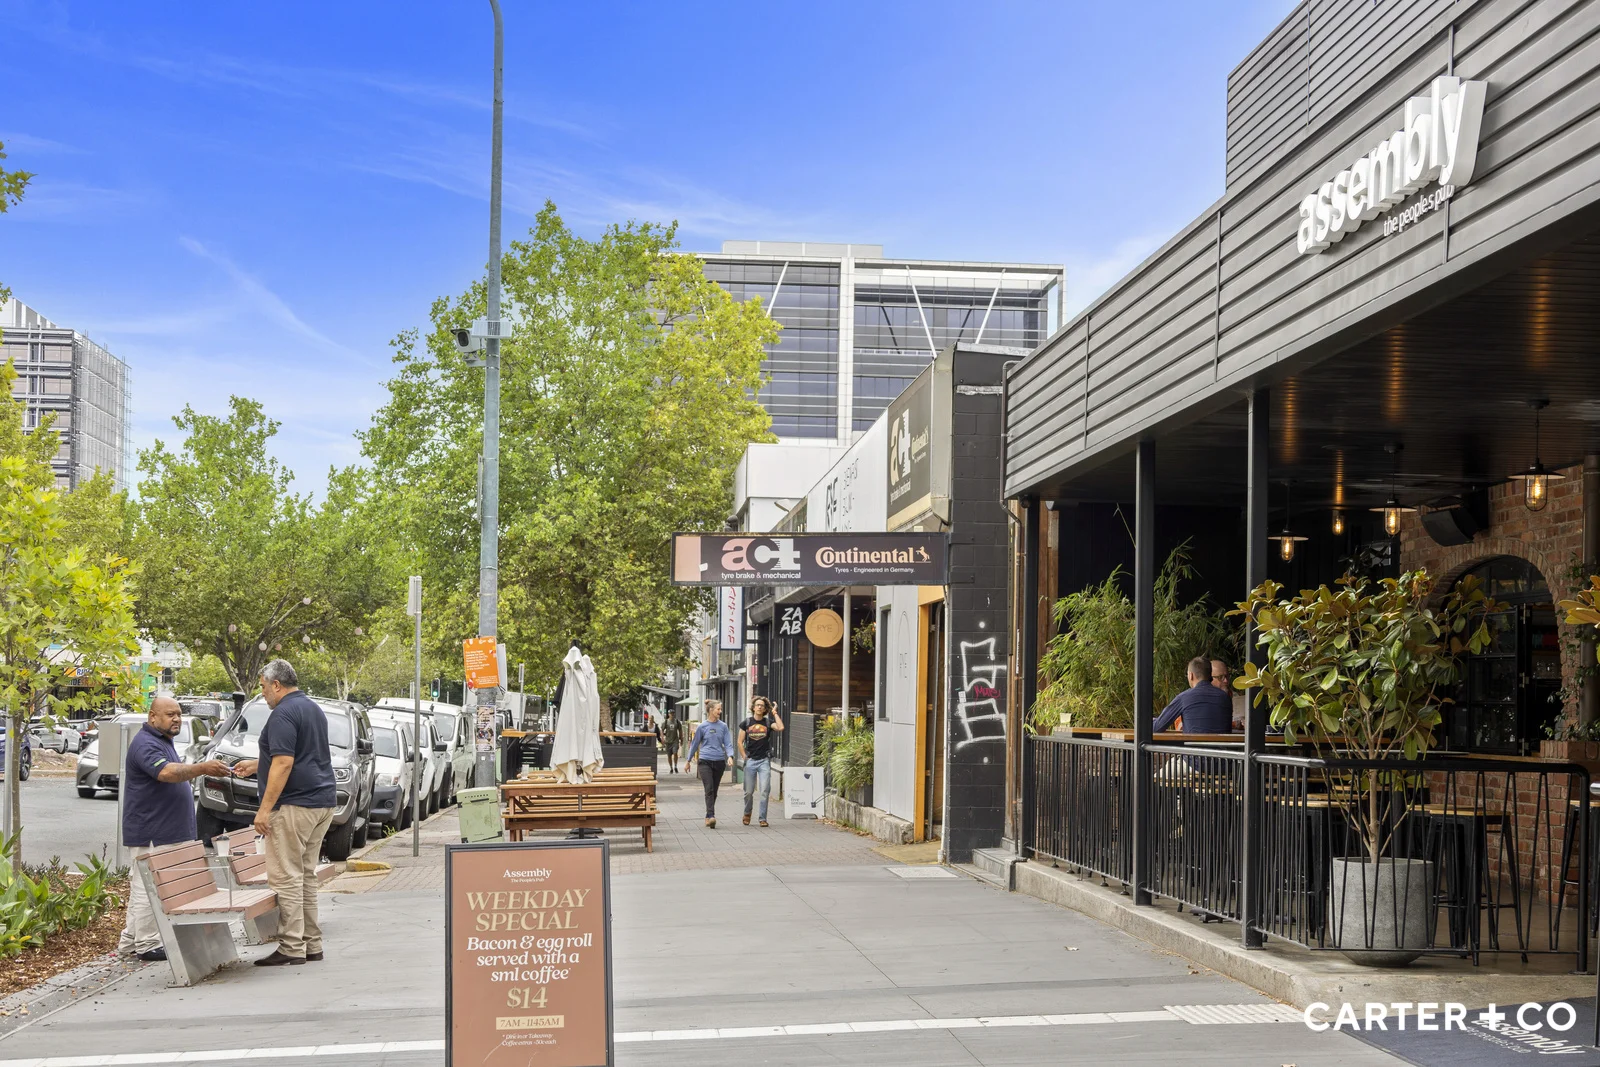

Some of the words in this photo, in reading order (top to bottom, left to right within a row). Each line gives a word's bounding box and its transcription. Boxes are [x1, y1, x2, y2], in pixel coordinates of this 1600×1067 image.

[1297, 76, 1488, 254] assembly
[1383, 216, 1399, 236] the
[1434, 184, 1455, 210] pub
[890, 408, 911, 486] act
[721, 538, 801, 571] act
[815, 546, 915, 568] Continental
[721, 572, 734, 580] tyre
[781, 607, 803, 621] ZA
[780, 621, 802, 635] AB
[816, 624, 833, 633] RYE
[503, 868, 553, 879] Assembly
[466, 889, 591, 911] WEEKDAY
[475, 910, 579, 932] SPECIAL
[466, 936, 517, 951] Bacon
[520, 935, 535, 950] &
[536, 937, 564, 953] egg
[566, 933, 592, 948] roll
[476, 951, 529, 966] served
[531, 951, 567, 964] with
[569, 952, 580, 963] a
[490, 967, 519, 982] sml
[506, 985, 548, 1009] $14
[500, 1019, 520, 1028] 7AM
